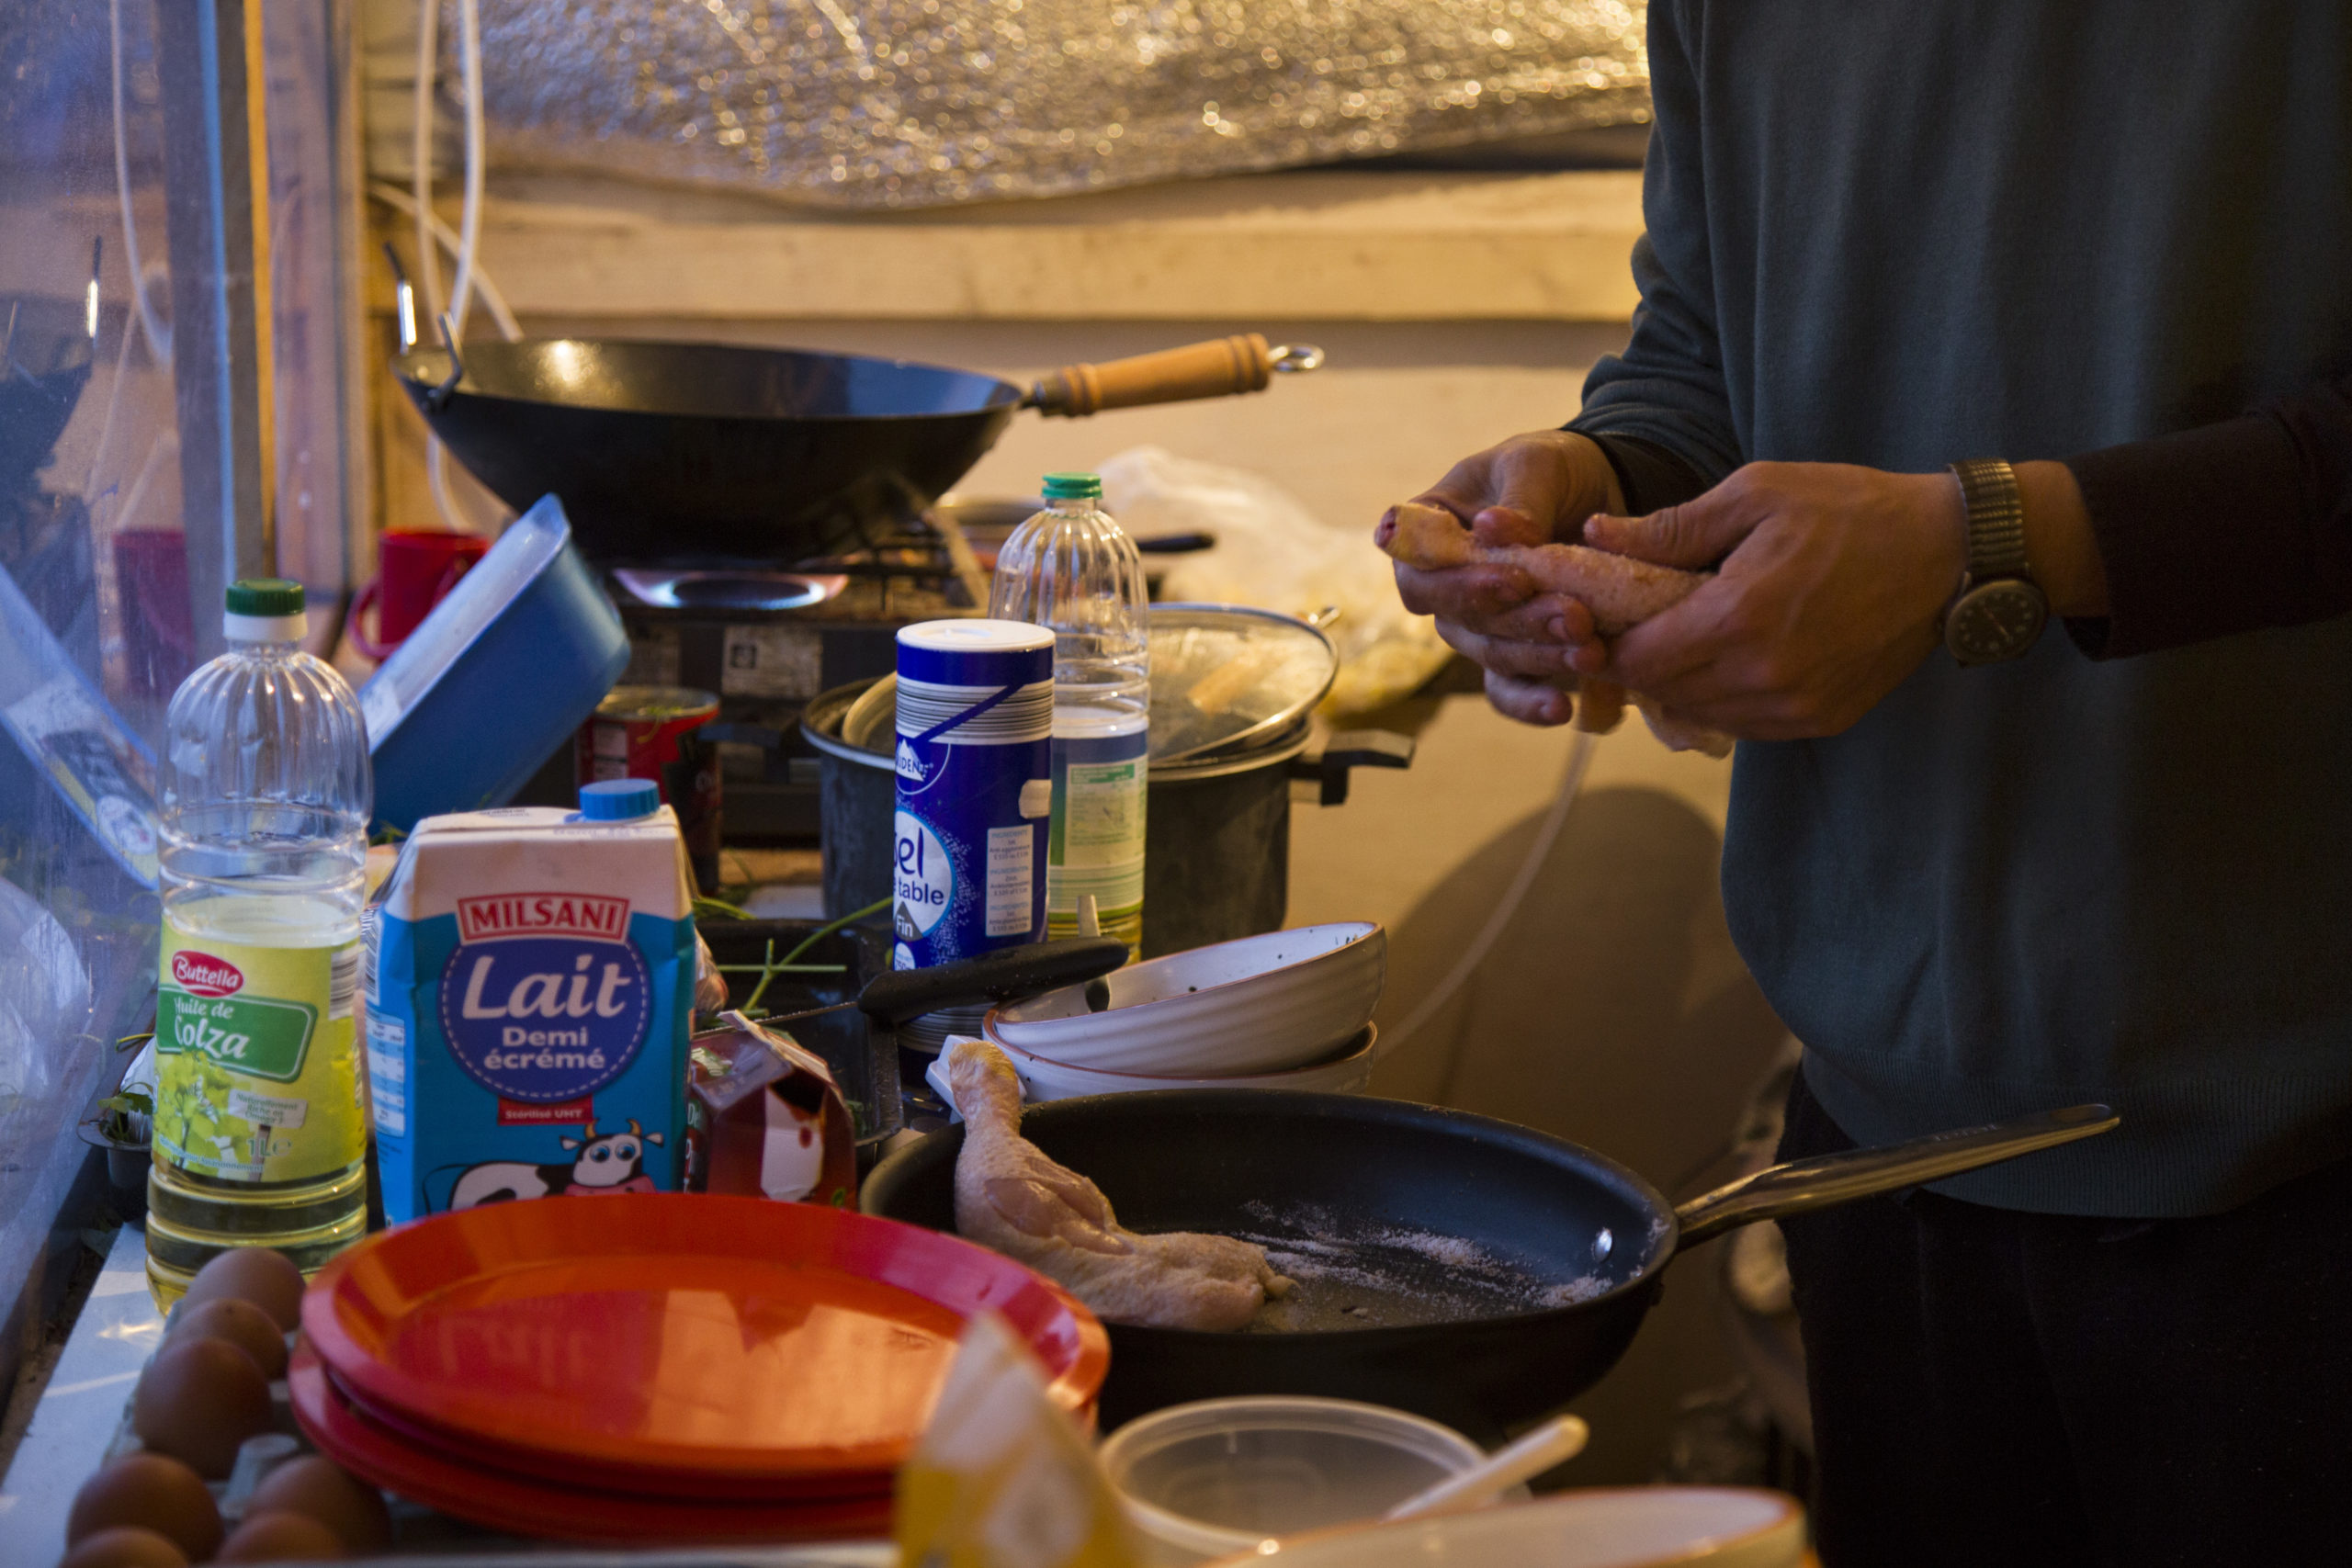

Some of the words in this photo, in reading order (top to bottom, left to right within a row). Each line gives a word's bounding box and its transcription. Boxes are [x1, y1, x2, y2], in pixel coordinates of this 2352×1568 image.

[899, 877, 944, 906] table
[469, 897, 617, 934] MILSANI
[896, 914, 913, 938] Fin
[173, 955, 239, 988] Buttella
[462, 953, 632, 1020] Lait
[210, 998, 234, 1019] de
[175, 1014, 250, 1059] Colza
[503, 1026, 588, 1046] Demi
[483, 1048, 605, 1070] écrémé
[505, 1108, 551, 1120] Stérilisé
[555, 1108, 583, 1119] UHT
